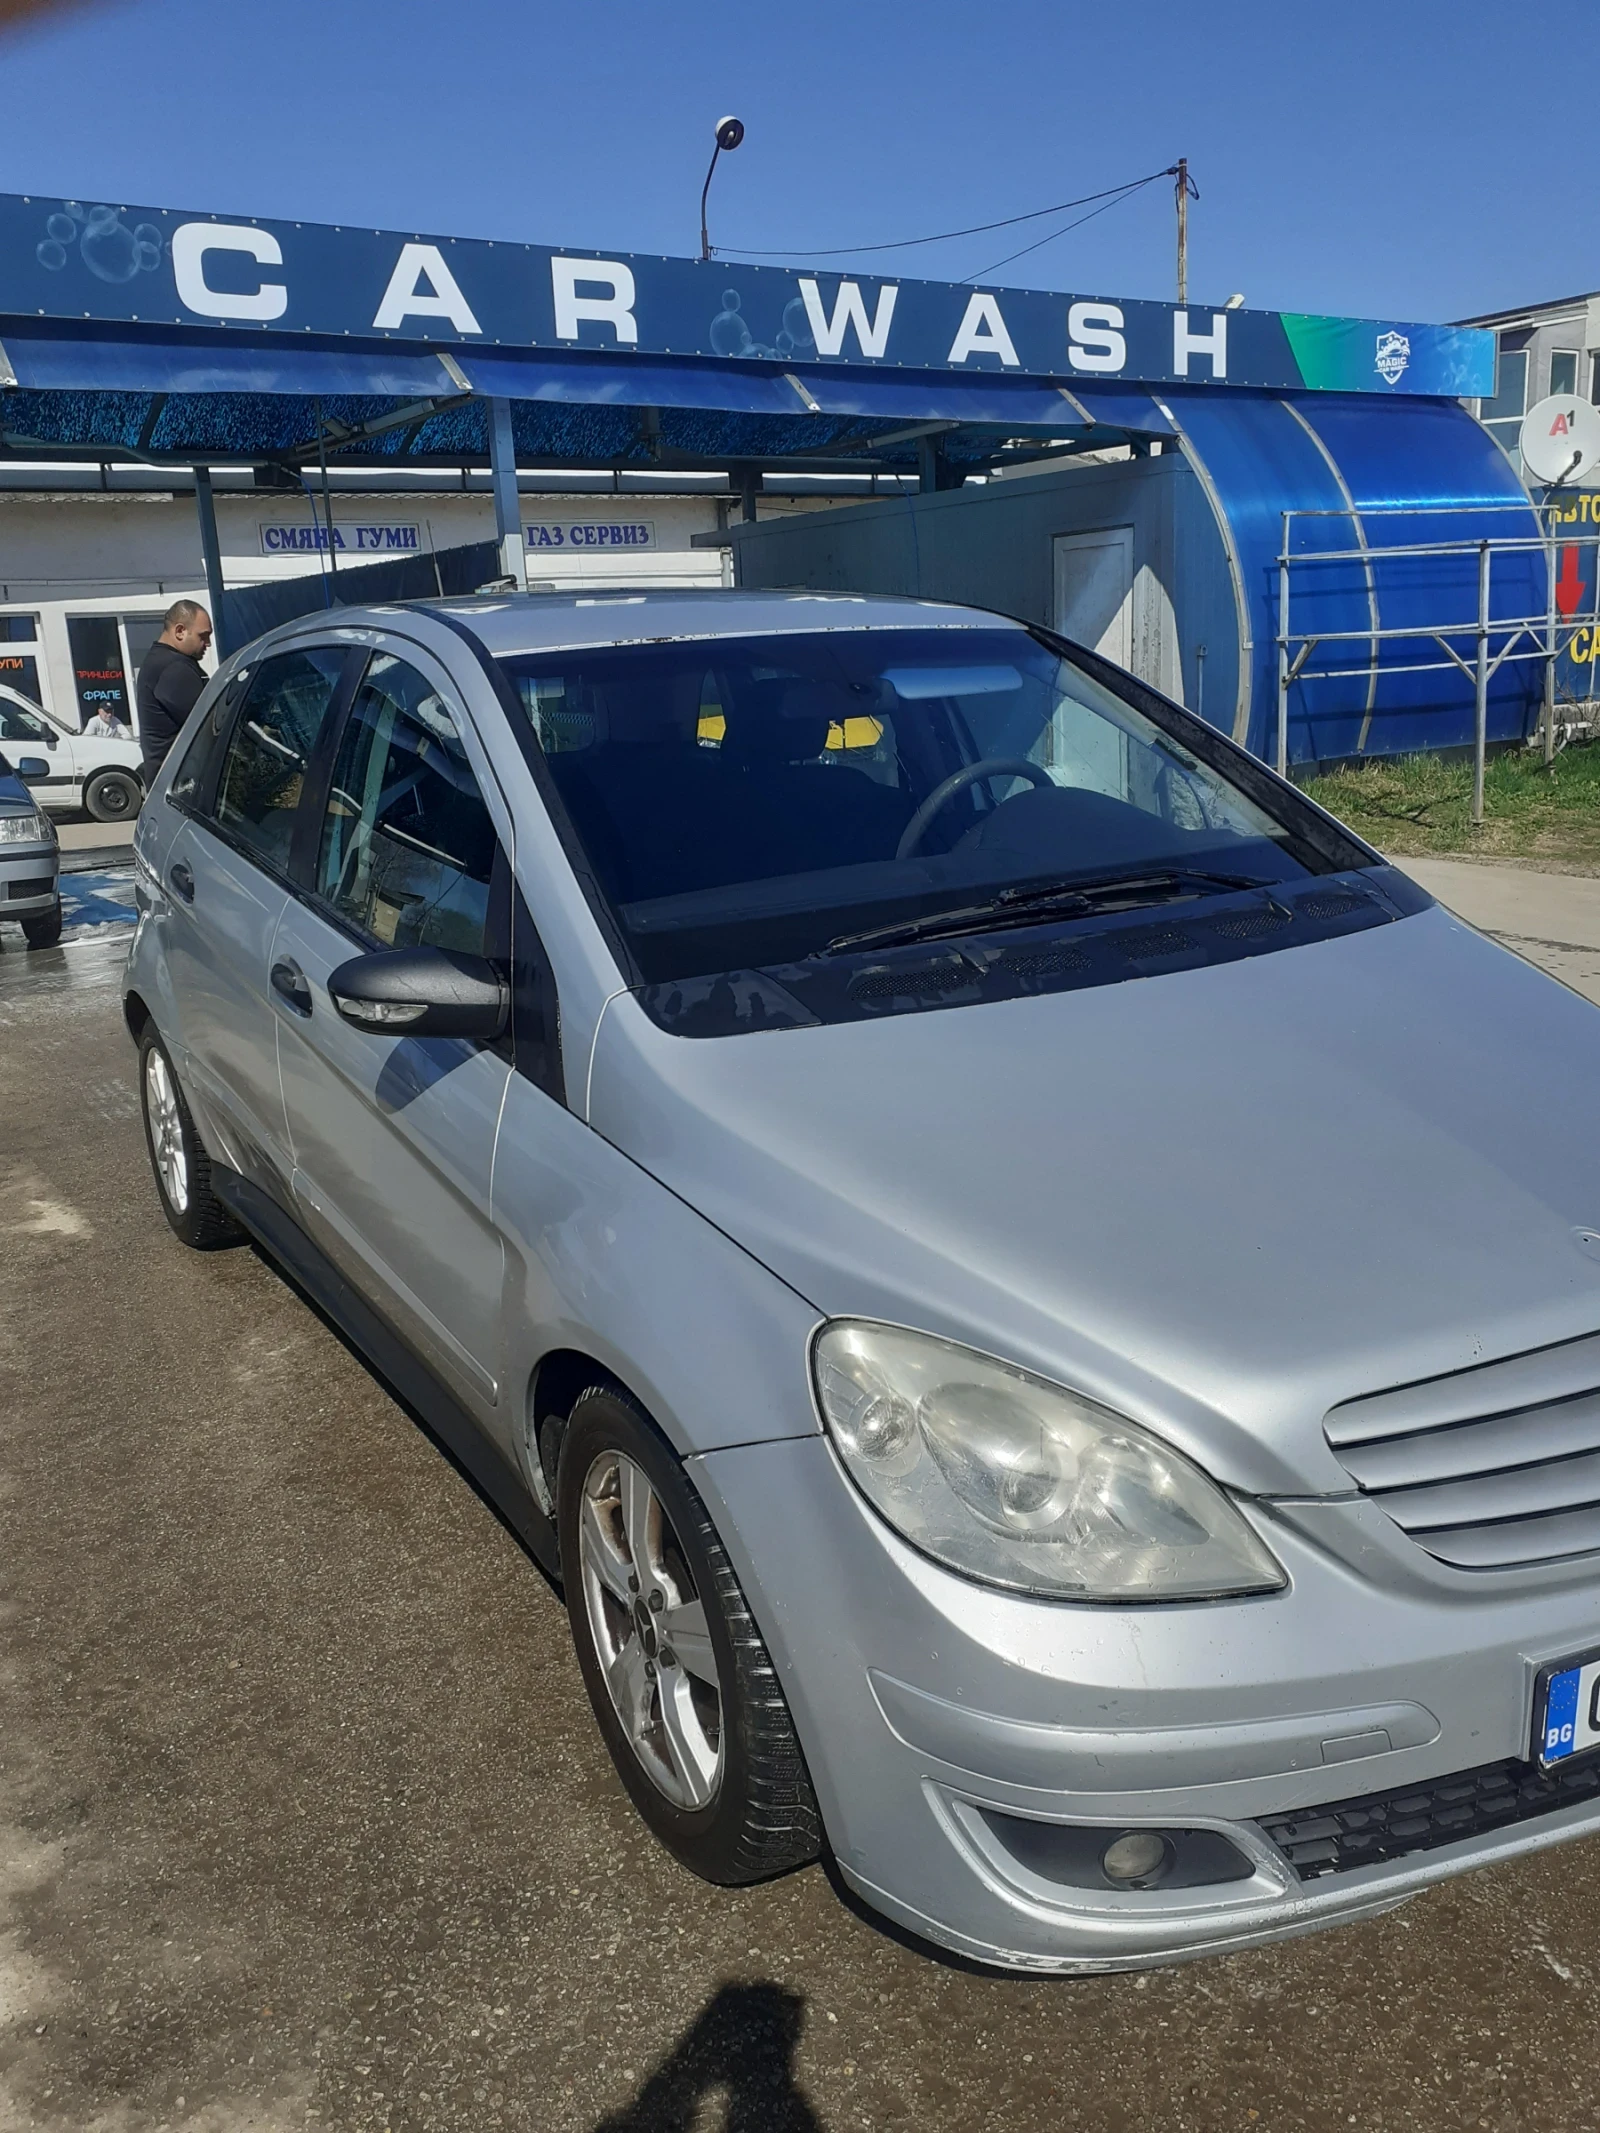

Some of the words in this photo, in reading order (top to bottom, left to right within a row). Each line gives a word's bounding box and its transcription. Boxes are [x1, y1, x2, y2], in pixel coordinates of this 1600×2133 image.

[171, 222, 638, 343] CAR
[797, 278, 1228, 379] WASH
[1377, 357, 1407, 368] MAGIC
[1549, 409, 1575, 436] A1
[265, 528, 346, 549] СМЯНА
[356, 527, 418, 548] ГУМИ
[527, 526, 564, 546] ГАЗ
[570, 525, 649, 545] СЕРВИЗ
[83, 689, 122, 701] ФРАПЕ
[1547, 1723, 1572, 1749] BG
